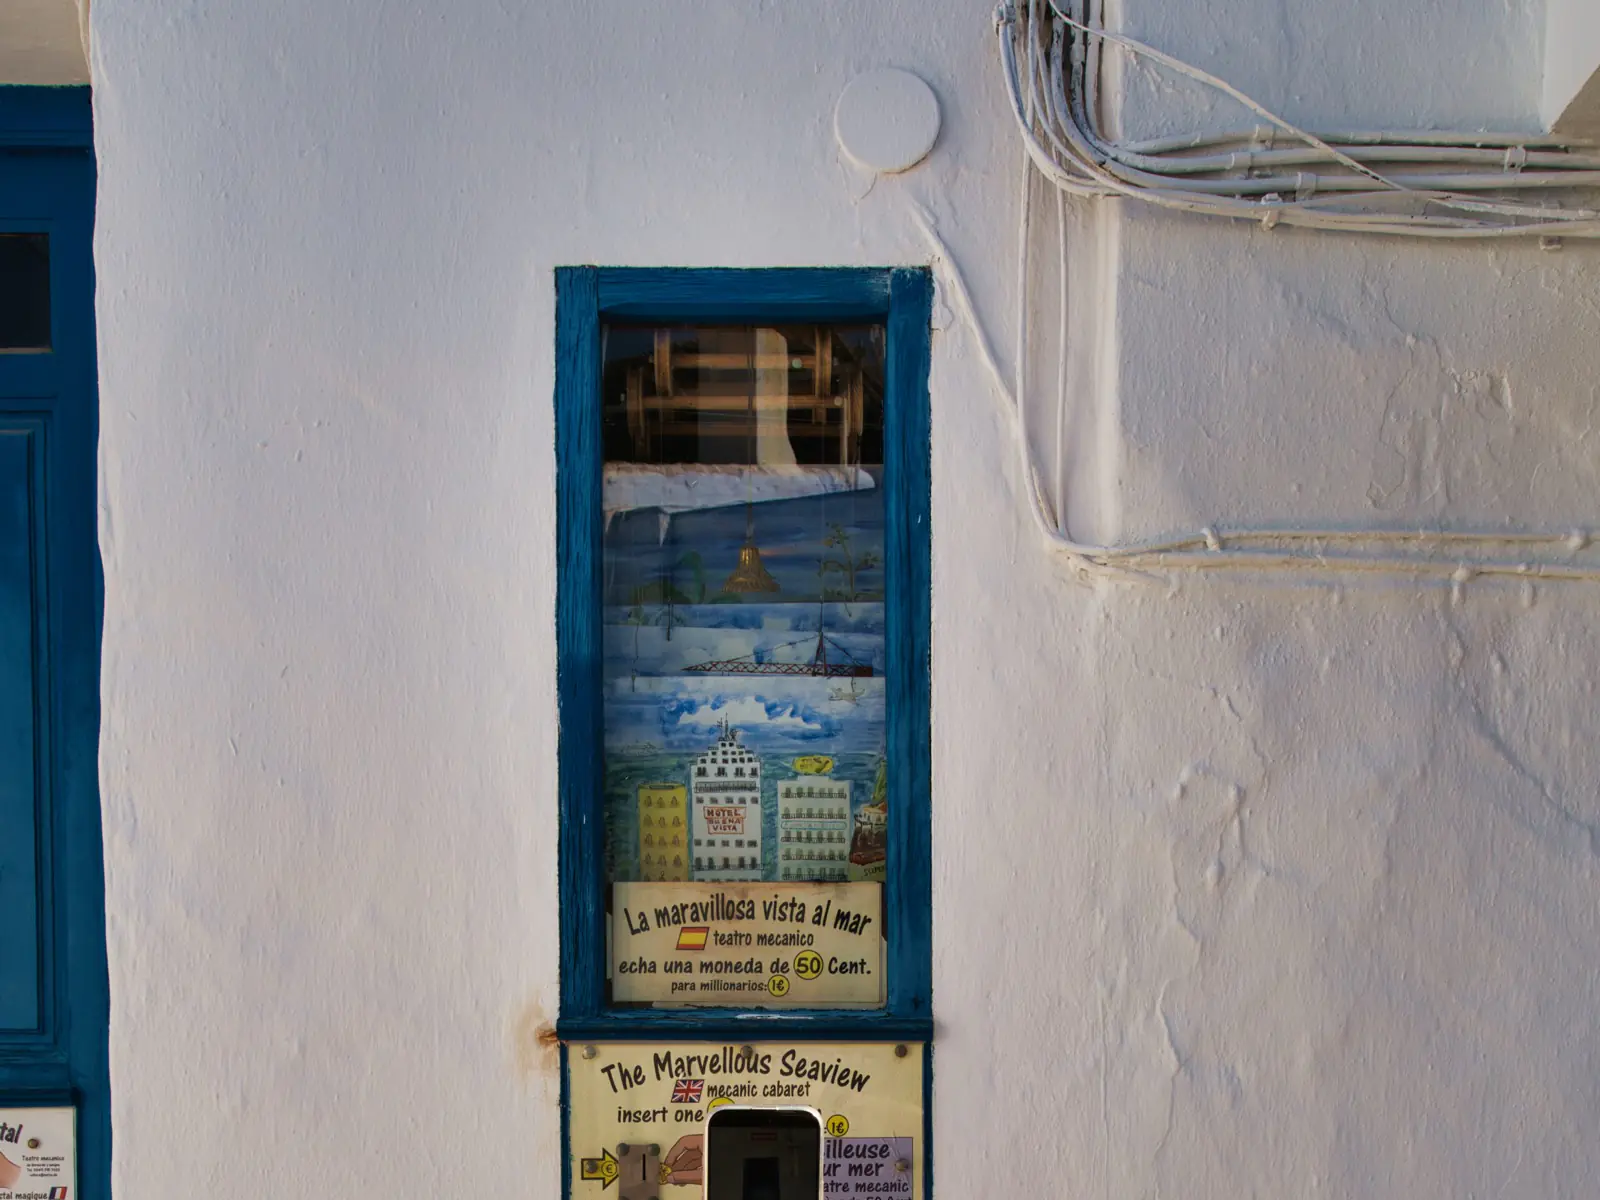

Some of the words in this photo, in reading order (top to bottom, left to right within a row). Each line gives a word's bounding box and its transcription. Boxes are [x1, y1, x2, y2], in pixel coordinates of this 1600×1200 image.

[707, 808, 741, 817] HOTEL
[624, 908, 650, 936] La
[654, 892, 755, 928] maravillosa
[763, 894, 806, 923] vista
[811, 899, 831, 927] al
[833, 908, 872, 936] mar
[713, 930, 752, 946] teatro
[756, 929, 814, 946] mecanico
[619, 956, 657, 974] echa
[663, 960, 693, 974] una
[699, 957, 763, 974] moneda
[769, 957, 790, 974] de
[796, 957, 821, 974] 50
[828, 956, 872, 974] Cent.
[671, 981, 696, 994] para
[700, 979, 768, 992] millionarios:
[600, 1062, 646, 1093] The
[653, 1046, 772, 1081] Marvellous
[780, 1049, 870, 1092] Seaview
[707, 1080, 758, 1097] mecanic
[762, 1080, 811, 1097] cabaret
[617, 1106, 668, 1123] insert
[674, 1109, 704, 1122] one
[824, 1139, 890, 1159] illeuse
[848, 1162, 884, 1177] mer
[823, 1180, 850, 1192] atre
[855, 1179, 909, 1192] mecanic
